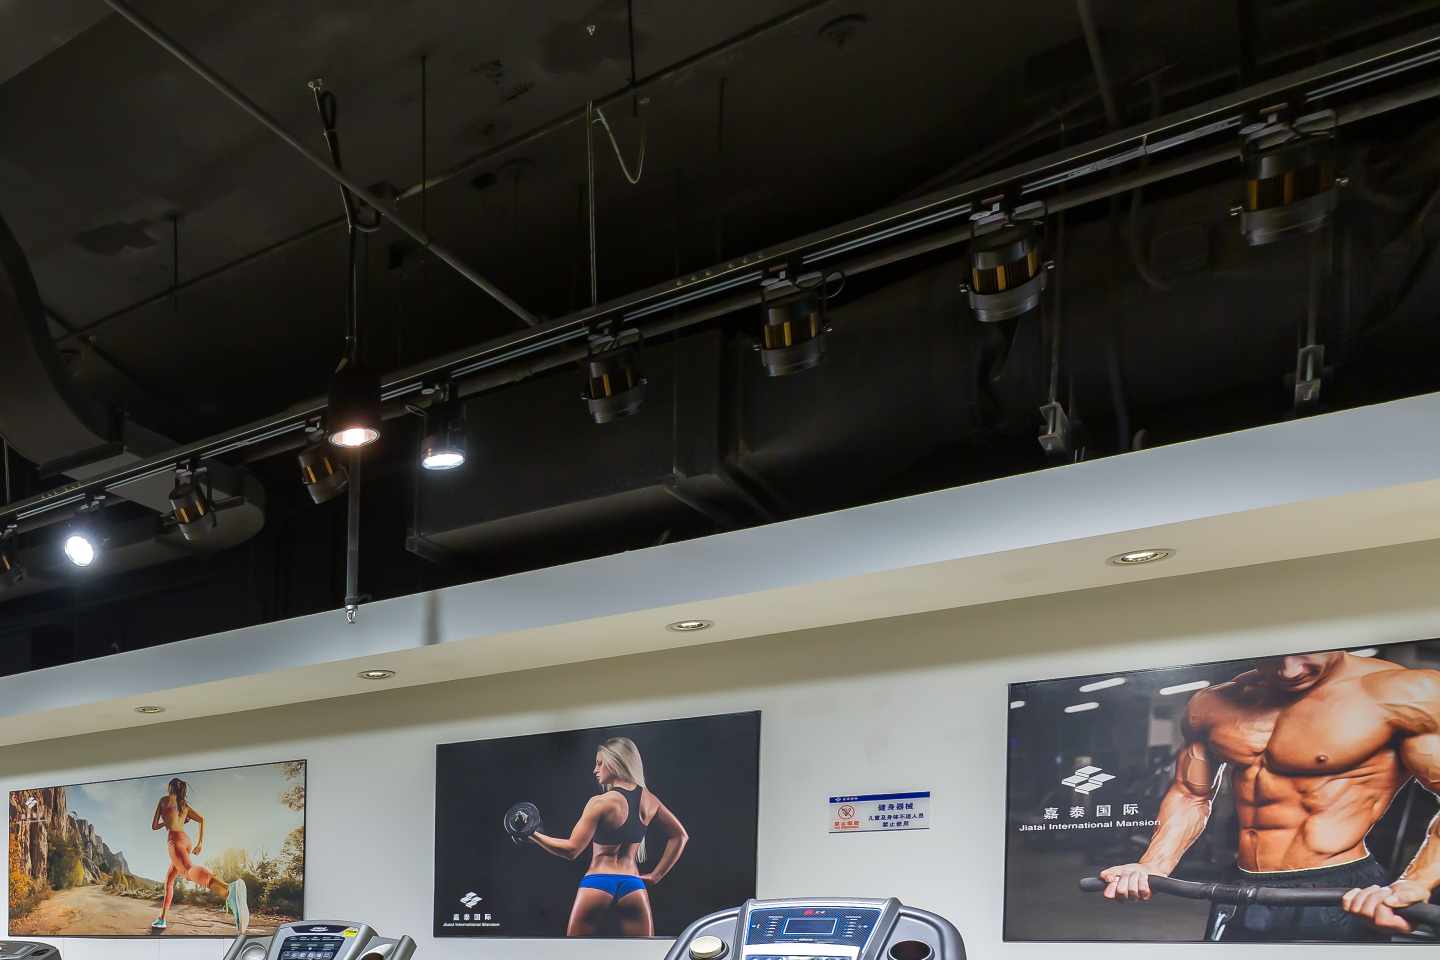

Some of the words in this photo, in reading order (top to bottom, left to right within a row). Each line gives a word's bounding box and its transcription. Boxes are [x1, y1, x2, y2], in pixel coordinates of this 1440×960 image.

[877, 802, 914, 812] 健身器械
[1043, 803, 1139, 820] 嘉泰国际
[1019, 823, 1046, 832] Jiatai
[1049, 821, 1113, 831] International
[1116, 819, 1161, 828] Mansion
